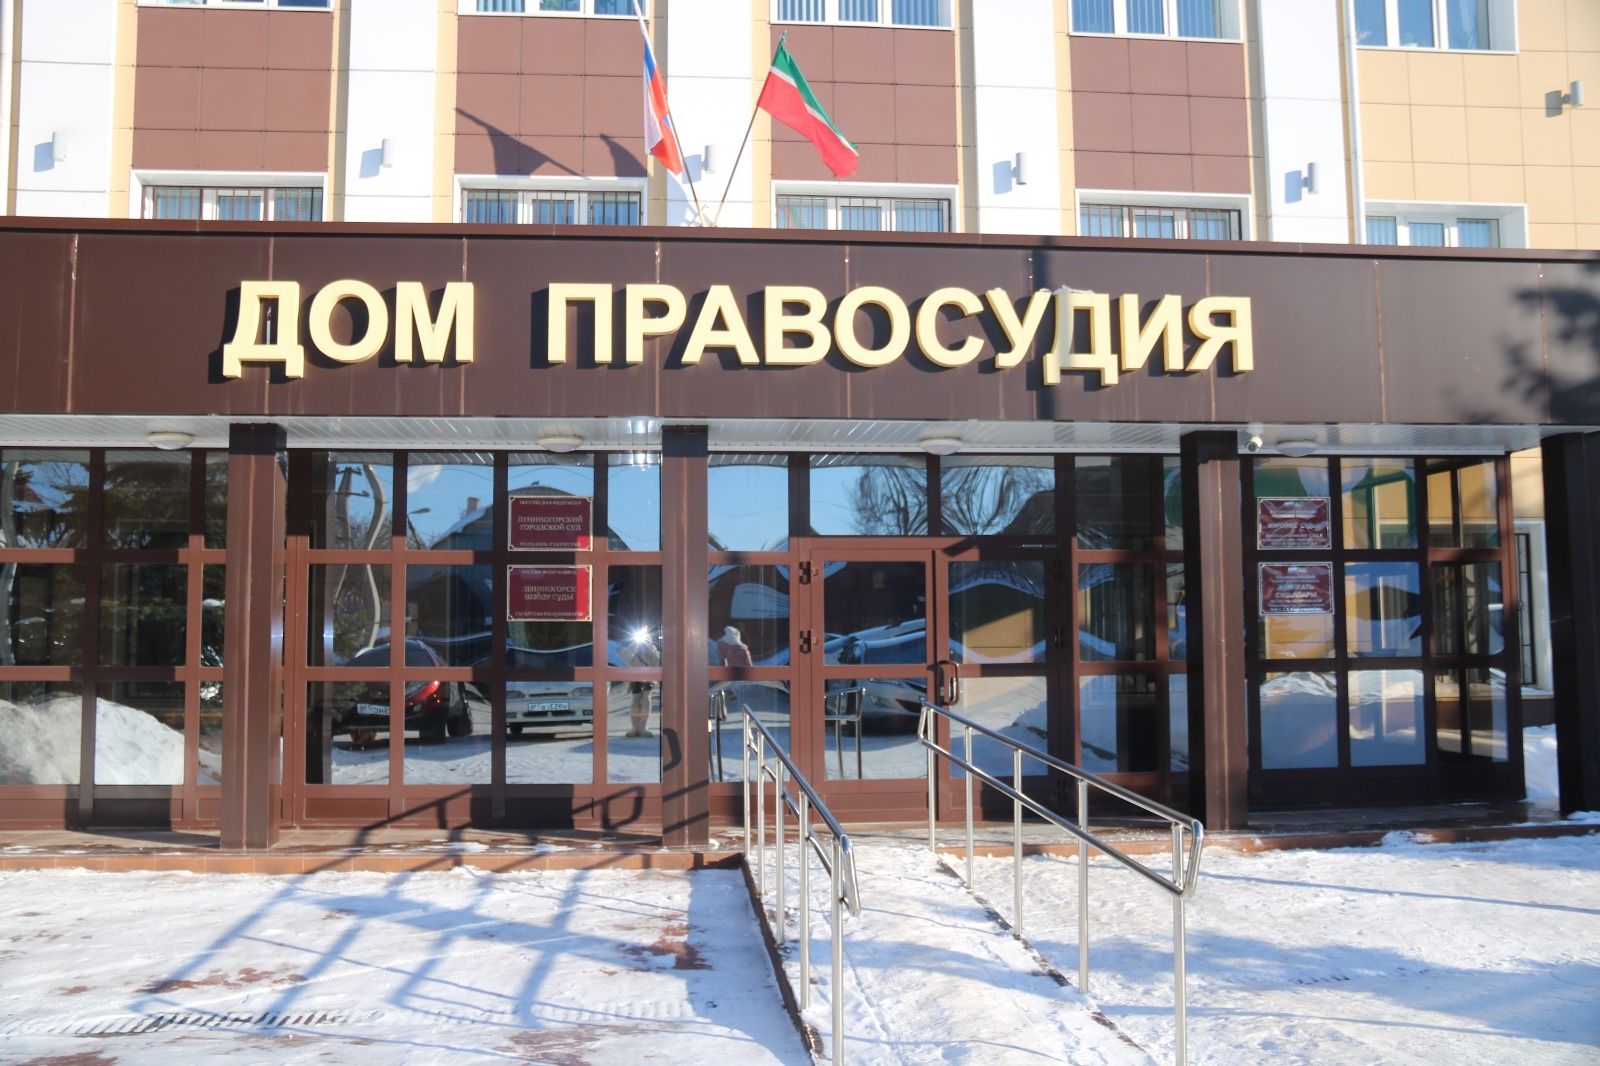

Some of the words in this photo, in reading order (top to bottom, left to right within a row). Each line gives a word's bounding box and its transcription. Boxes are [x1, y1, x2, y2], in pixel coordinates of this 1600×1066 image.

[222, 280, 475, 380] ДОМ
[545, 282, 1255, 386] ПРАВОСУДИЯ
[518, 515, 583, 523] ЛЕНИНОГОРСКИЙ
[520, 523, 565, 531] ГОРОДСКОЙ
[565, 524, 581, 532] СУД
